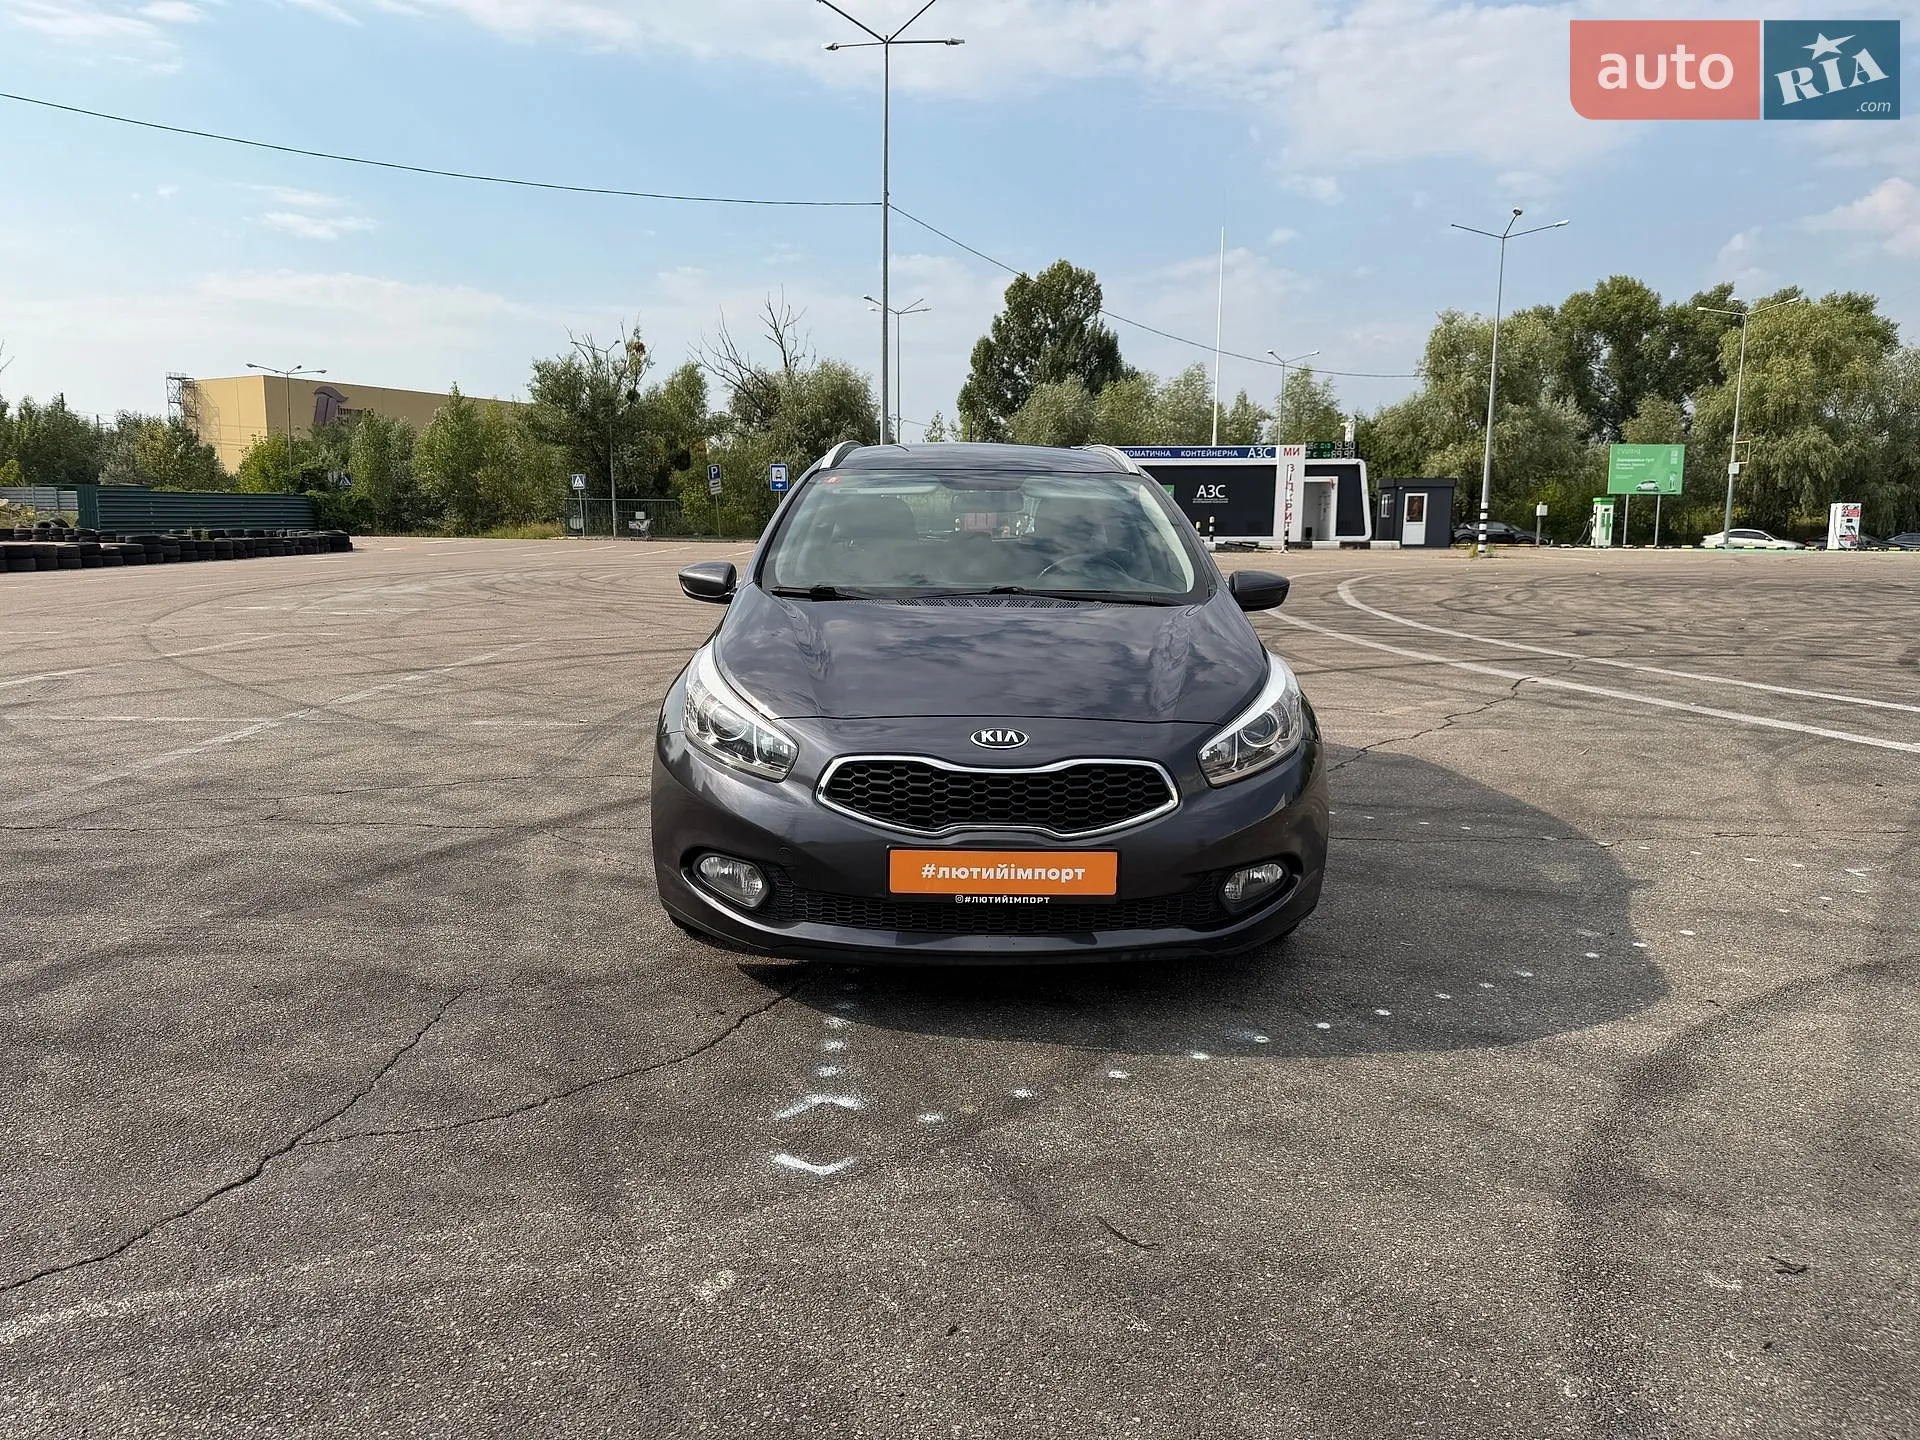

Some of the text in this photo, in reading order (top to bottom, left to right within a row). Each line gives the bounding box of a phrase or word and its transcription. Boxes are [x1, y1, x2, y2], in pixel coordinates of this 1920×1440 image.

[1180, 449, 1238, 457] КОНТЕЙНЕРНА
[1247, 447, 1272, 458] АЗС
[1283, 447, 1300, 456] МИ
[711, 466, 718, 478] P
[1196, 484, 1226, 498] АЗС
[980, 730, 1020, 743] KIA
[921, 863, 1086, 883] #лютийімпорт
[964, 894, 1051, 904] #ЛЮТИЙІМПОРТ
